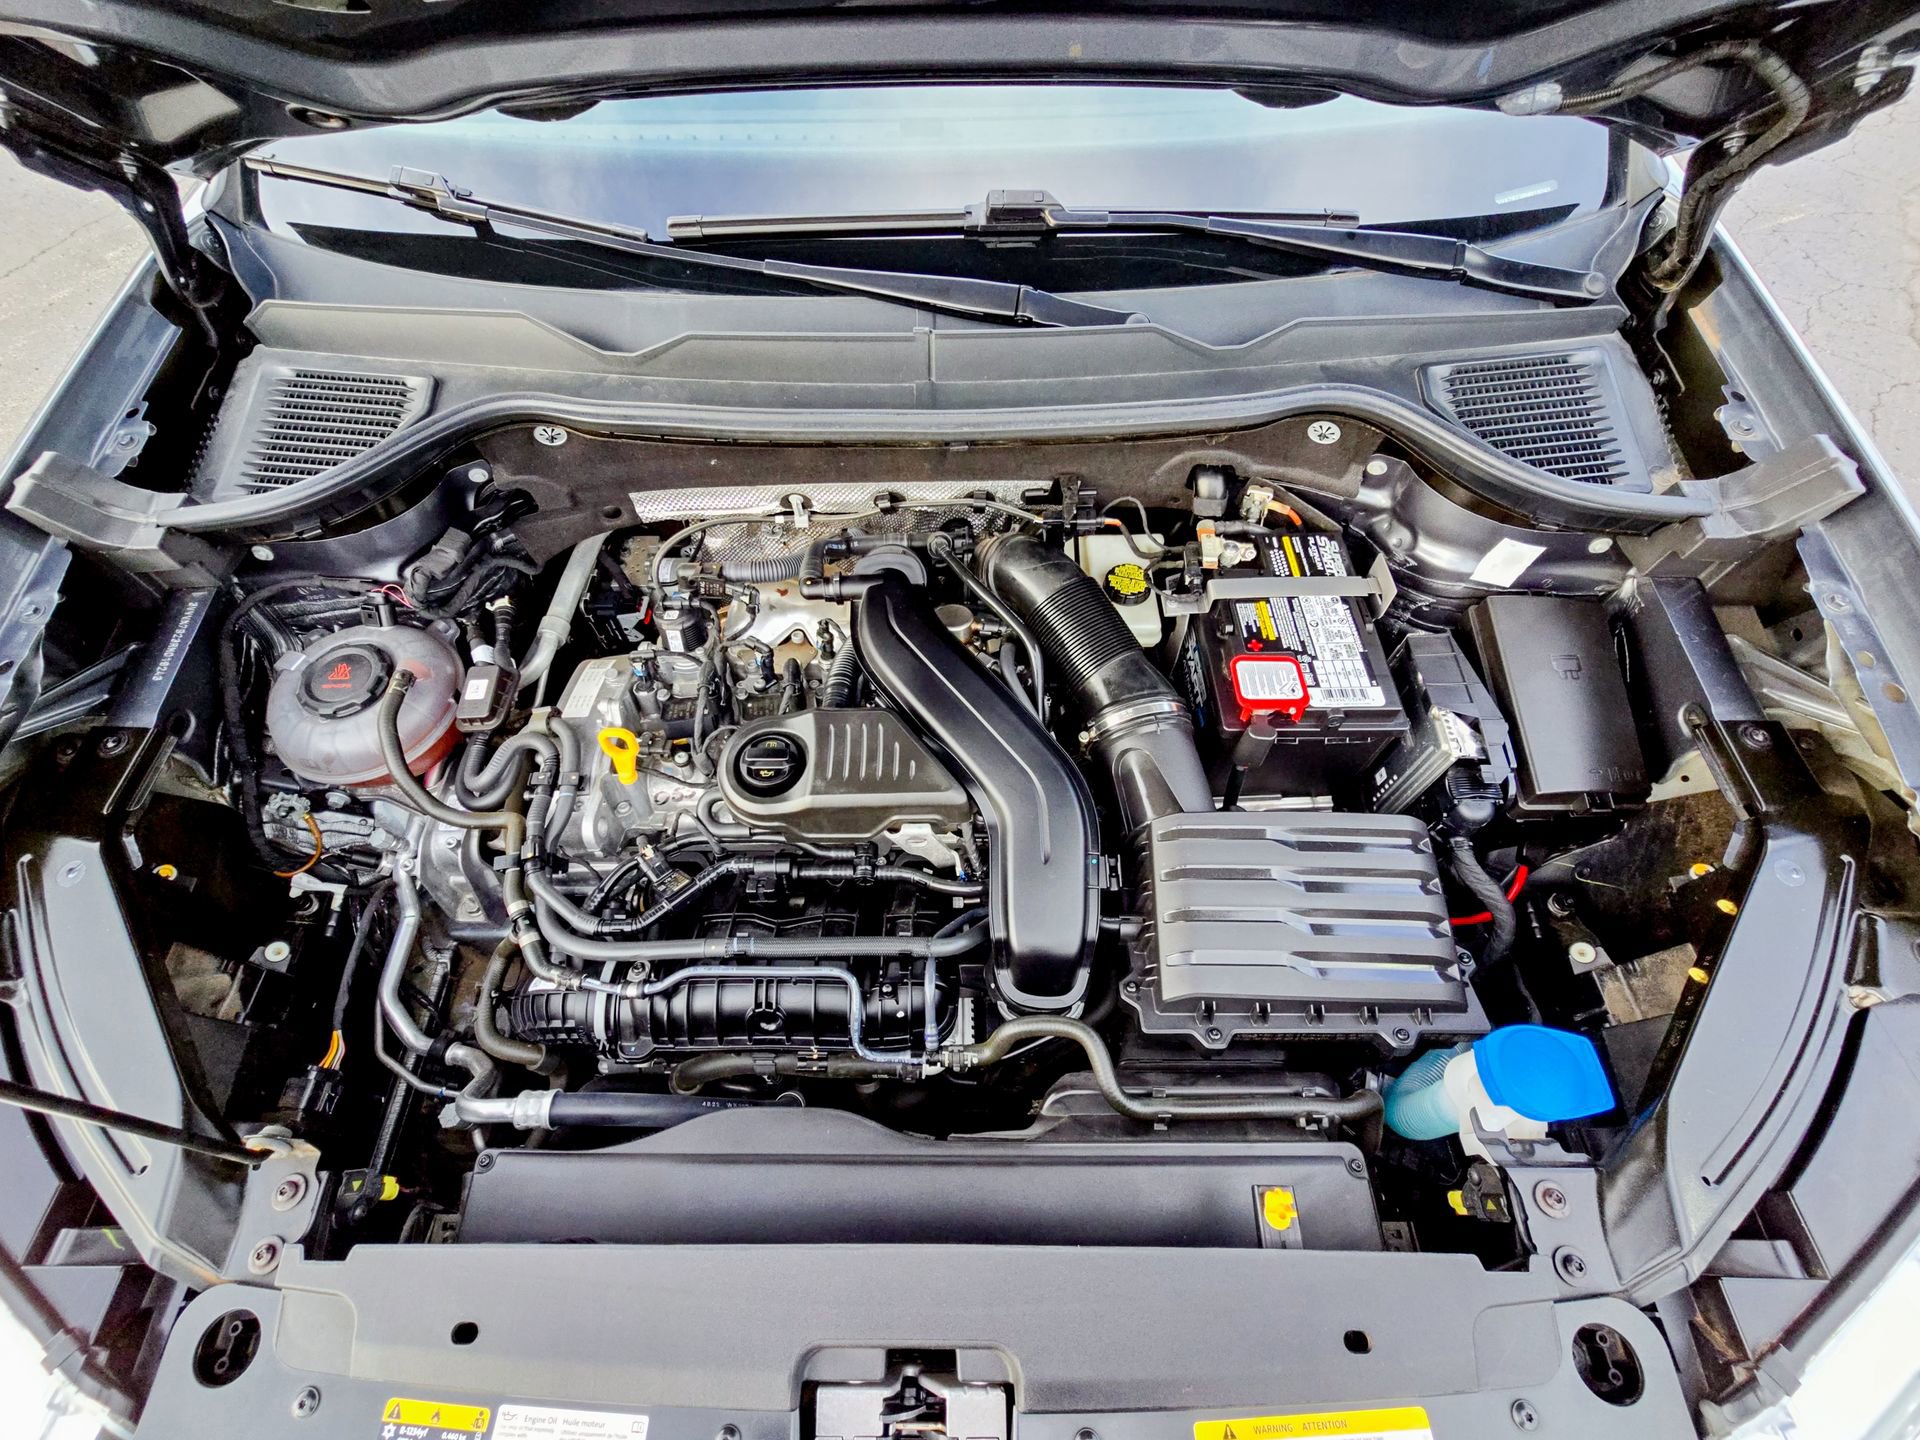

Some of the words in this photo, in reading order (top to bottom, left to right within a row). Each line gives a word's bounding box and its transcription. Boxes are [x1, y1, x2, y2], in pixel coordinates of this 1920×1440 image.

[1307, 536, 1325, 571] PLATINUM
[524, 1414, 546, 1426] Engine
[547, 1416, 557, 1425] Oil
[562, 1418, 580, 1426] Huile
[581, 1420, 606, 1429] moteur
[1253, 1423, 1294, 1435] WARNING
[1302, 1419, 1348, 1431] ATTENTION
